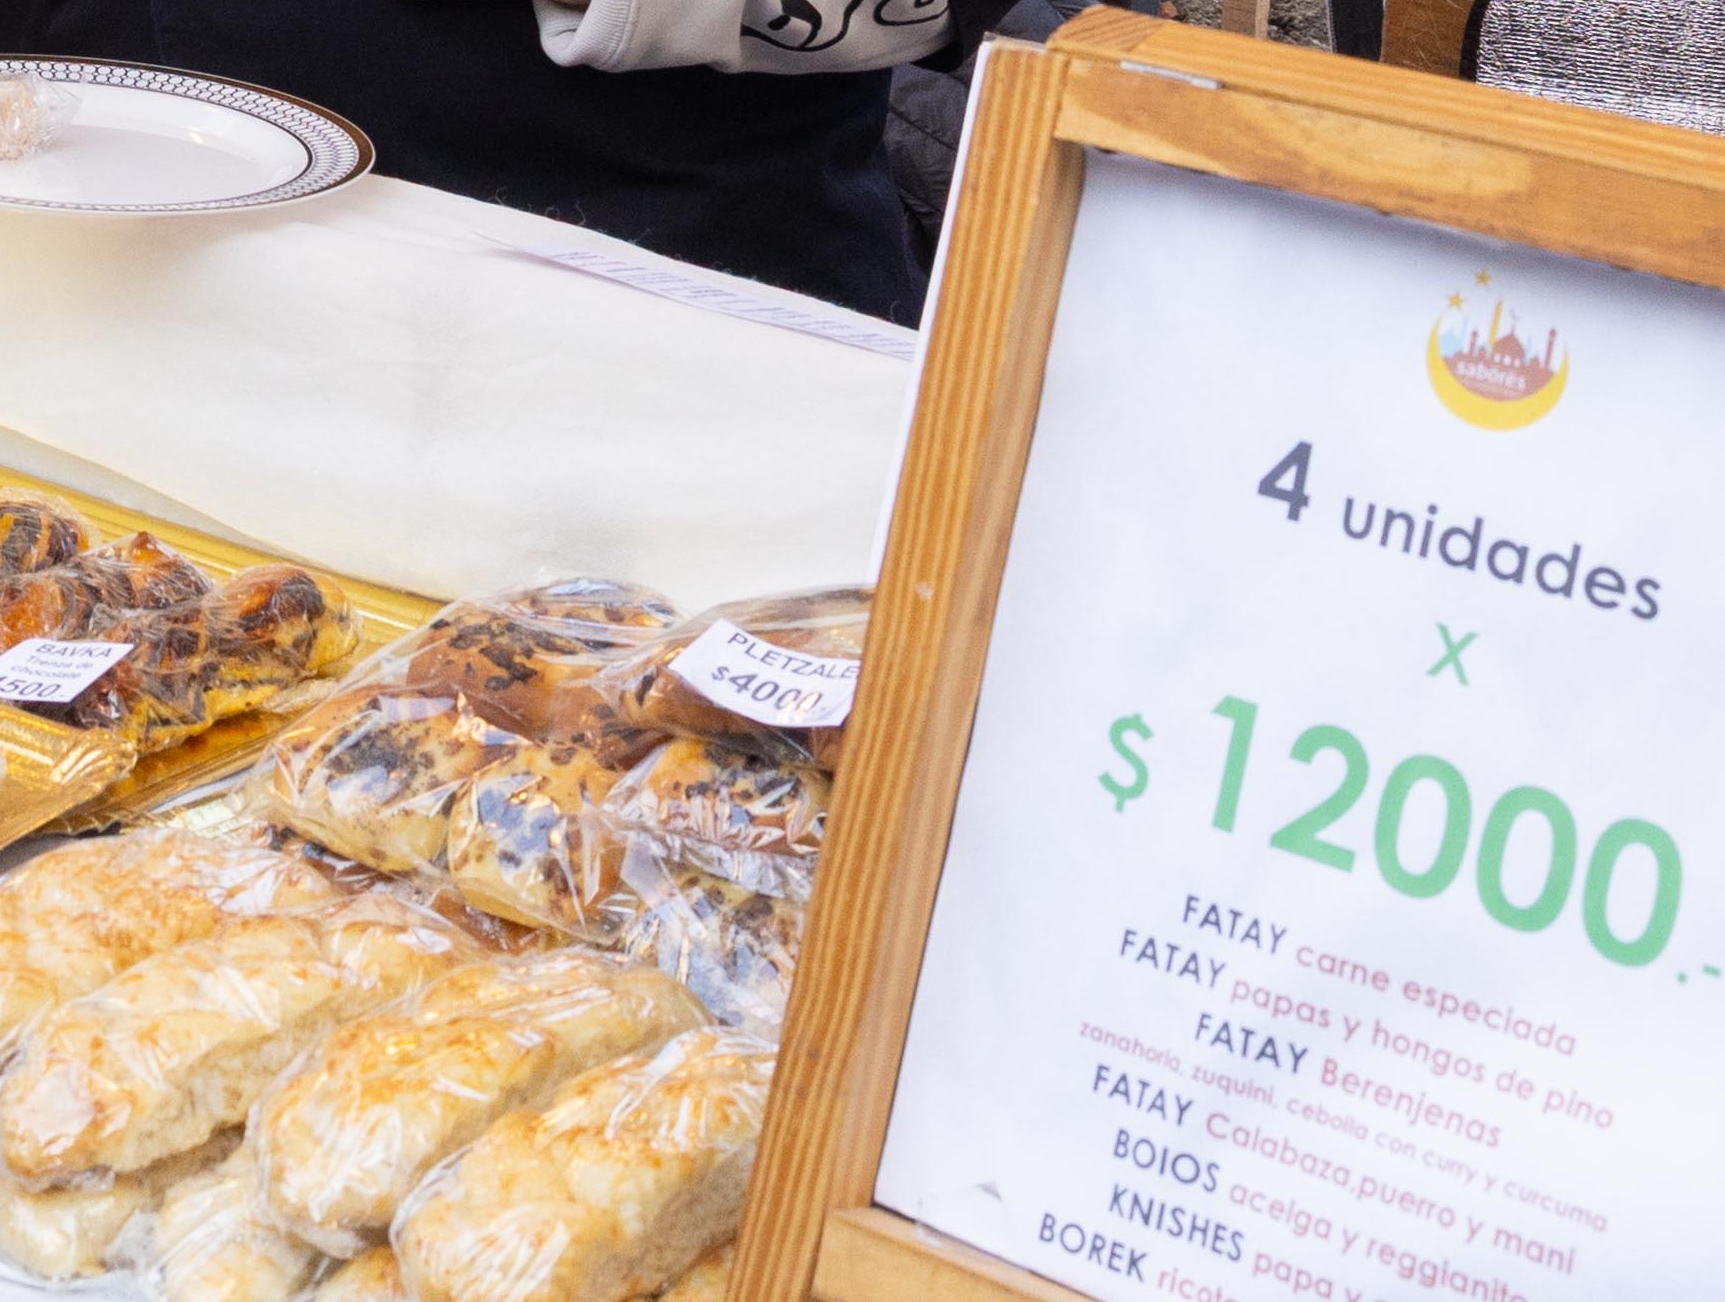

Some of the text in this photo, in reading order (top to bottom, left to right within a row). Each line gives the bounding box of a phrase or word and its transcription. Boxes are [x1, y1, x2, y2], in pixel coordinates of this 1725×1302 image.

[1257, 441, 1662, 620] 4 unidades
[36, 643, 111, 658] BAVKA
[1097, 713, 1153, 813] $
[1120, 928, 1614, 1130] FATAY papas y hongos de pino
[1182, 894, 1577, 1057] FATAY carne especiada
[1195, 1012, 1502, 1149] FATAY Berenjenas
[1092, 1064, 1194, 1127] FATAY
[1465, 1216, 1485, 1245] y
[1112, 1128, 1221, 1194] BOIOS
[1229, 1182, 1333, 1239] acelga
[1341, 1226, 1360, 1256] y
[1286, 1097, 1369, 1141] cebolla
[1375, 1131, 1417, 1160] con
[1422, 1148, 1478, 1187] curry
[1484, 1172, 1499, 1194] y
[1502, 1180, 1609, 1233] curcuma
[1039, 1212, 1147, 1282] BOREK
[1109, 1182, 1244, 1263] KNISHES
[1252, 1250, 1334, 1300] papa
